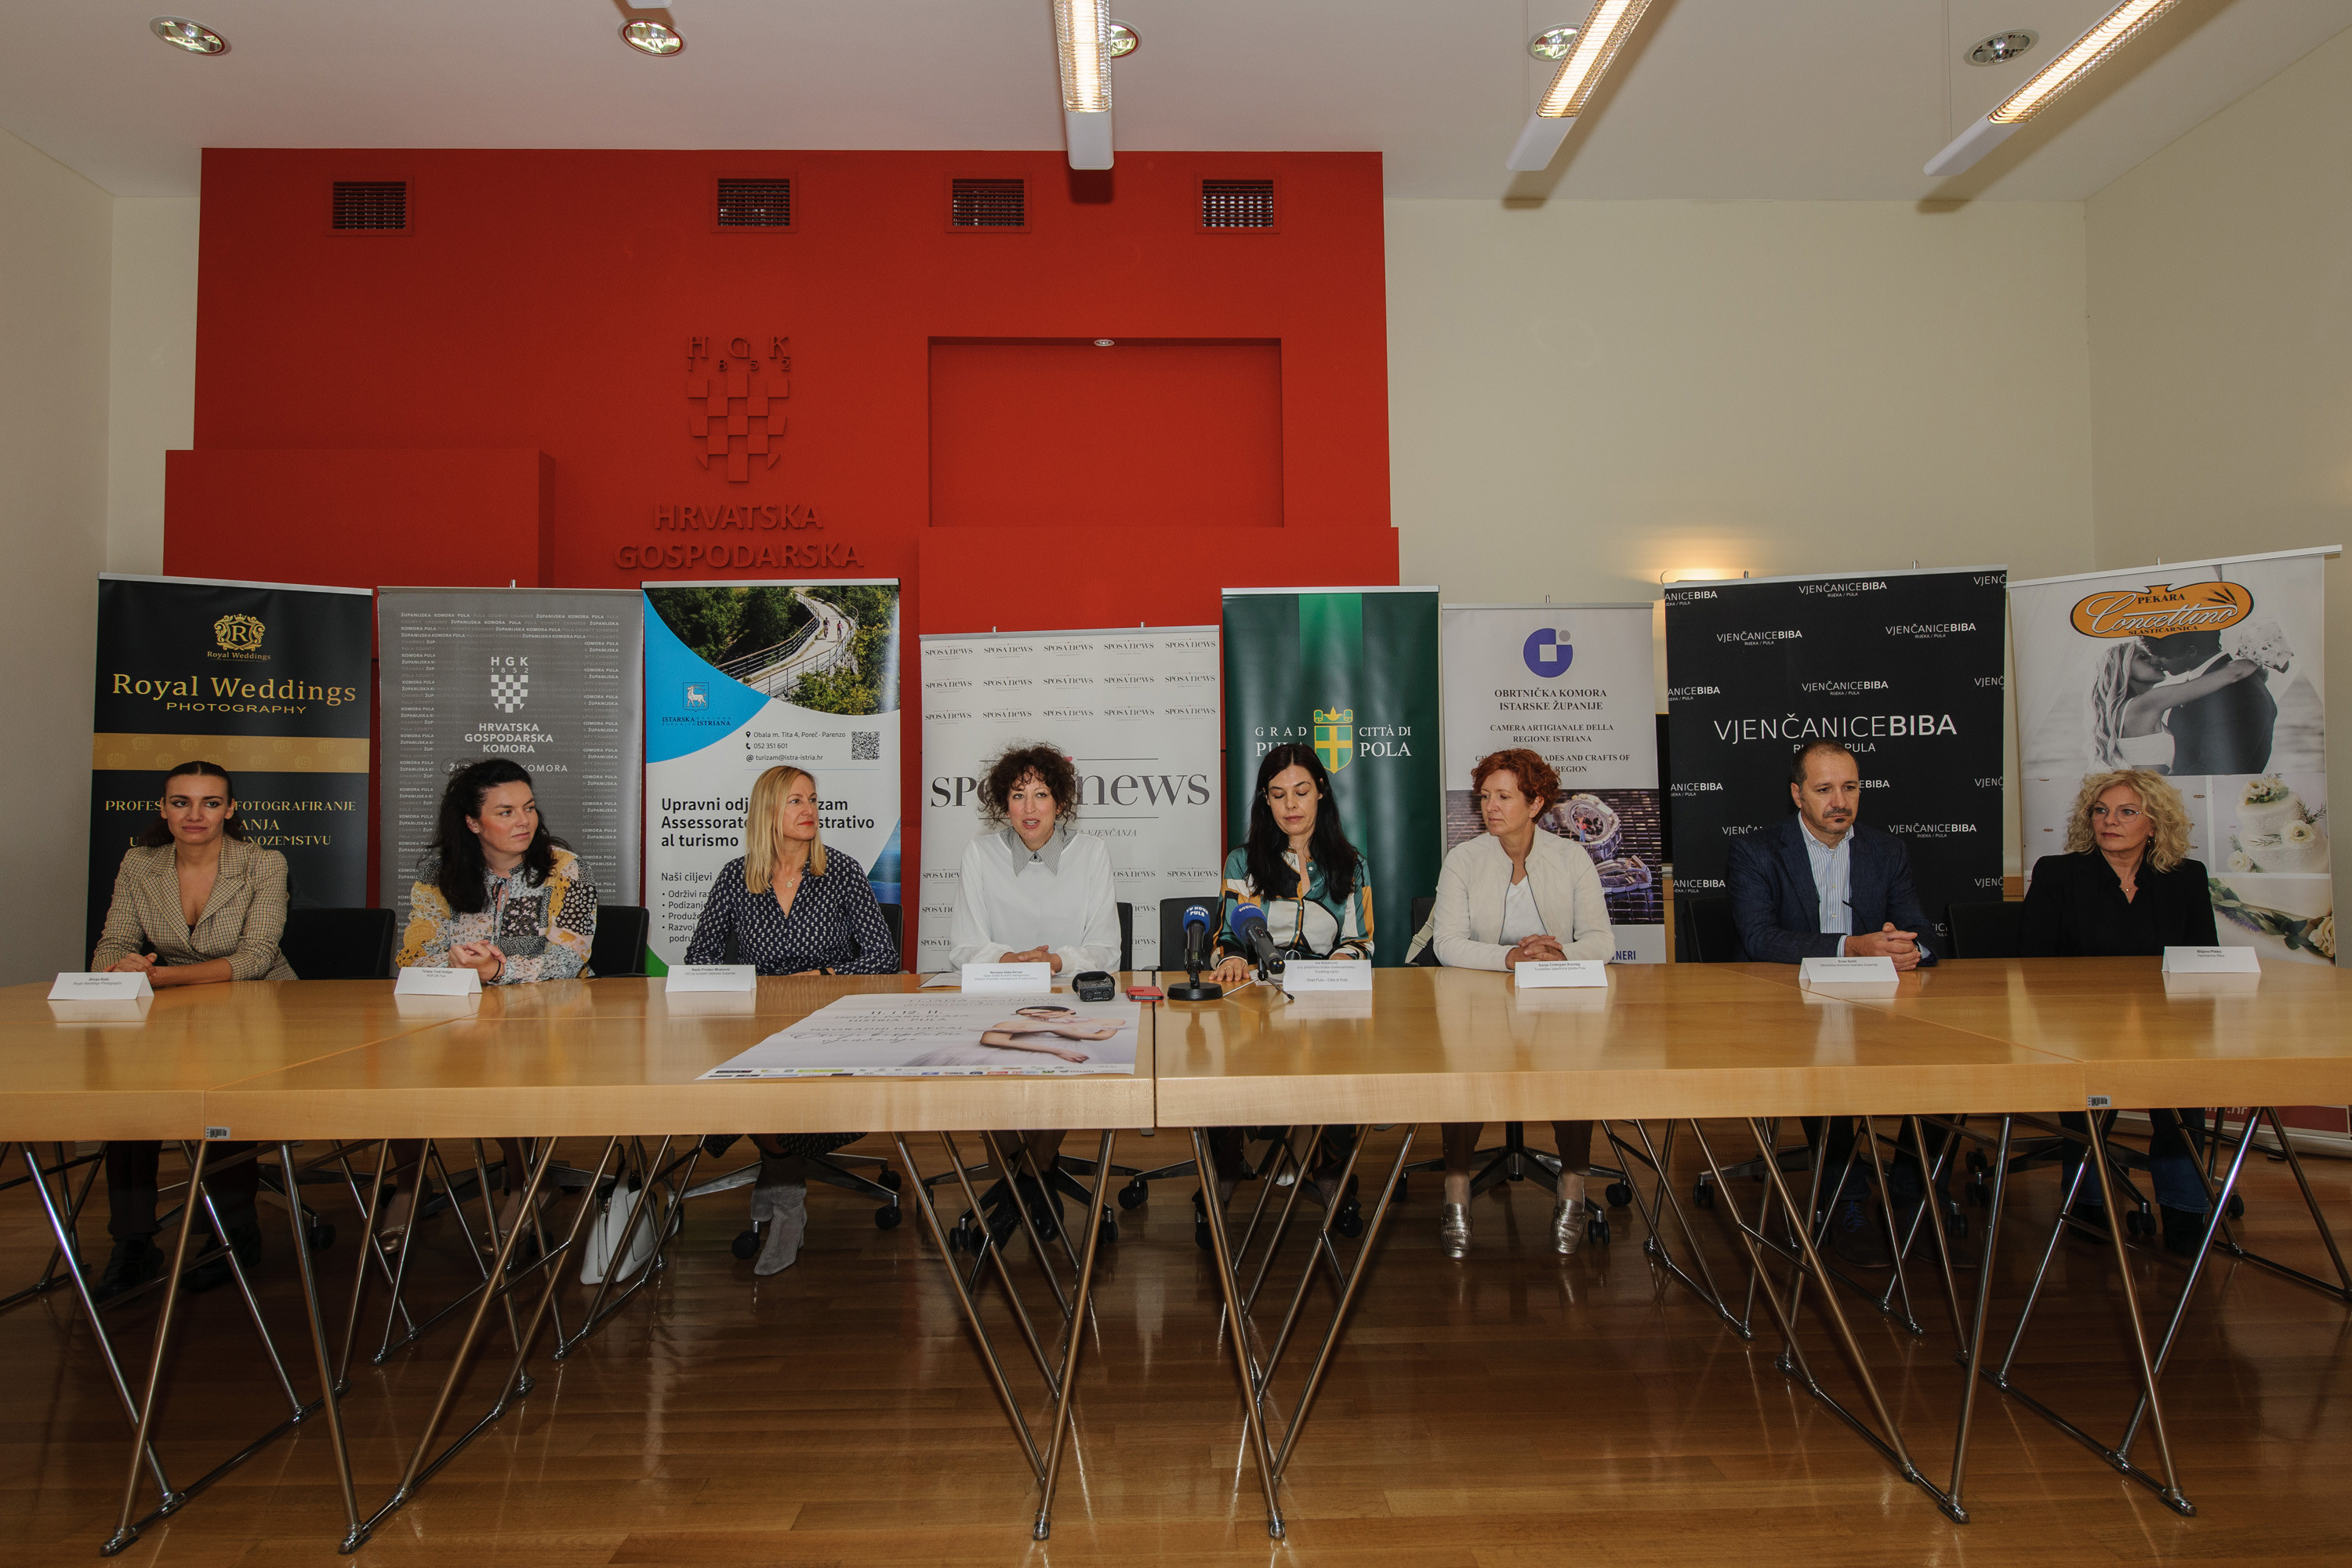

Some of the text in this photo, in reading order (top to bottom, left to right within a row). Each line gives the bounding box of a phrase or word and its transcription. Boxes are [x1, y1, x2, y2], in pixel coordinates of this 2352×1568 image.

[654, 505, 822, 529] HRVATSKA
[615, 543, 863, 568] GOSPODARSKA
[1798, 582, 1887, 595] VJENČANICEBIBA
[2138, 593, 2185, 604] PEKARA
[2086, 593, 2238, 633] Concettino
[1886, 622, 1976, 636] VJENČANICEBIBA
[1717, 630, 1802, 643] VJENČANICEBIBA
[207, 651, 271, 660] Royal Weddings
[113, 673, 356, 706] Royal Weddings
[1802, 681, 1889, 692] VJENČANICEBIBA
[1494, 688, 1556, 697] OBRTNIČKA
[166, 702, 307, 713] PHOTOGRAPHY
[1552, 700, 1602, 710] ŽUPANIJE
[479, 723, 539, 731] HRVATSKA
[1255, 727, 1307, 736] GRAD
[1359, 724, 1411, 737] CITTÀ DI
[1714, 713, 1957, 745] VJENČANICEBIBA
[465, 734, 554, 742] GOSPODARSKA
[1359, 742, 1411, 757] POLA
[105, 800, 356, 811] PROFES FOTOGRAFIRANJE
[662, 797, 720, 813] Upravni
[725, 797, 749, 813] odj
[818, 815, 874, 829] strativo
[1889, 823, 1976, 834] VJENČANICEBIBA
[662, 833, 739, 847] al turismo
[661, 872, 712, 883] Naši ciljevi
[669, 924, 695, 932] Razvoj
[670, 935, 692, 943] podru
[1616, 951, 1635, 960] NERI
